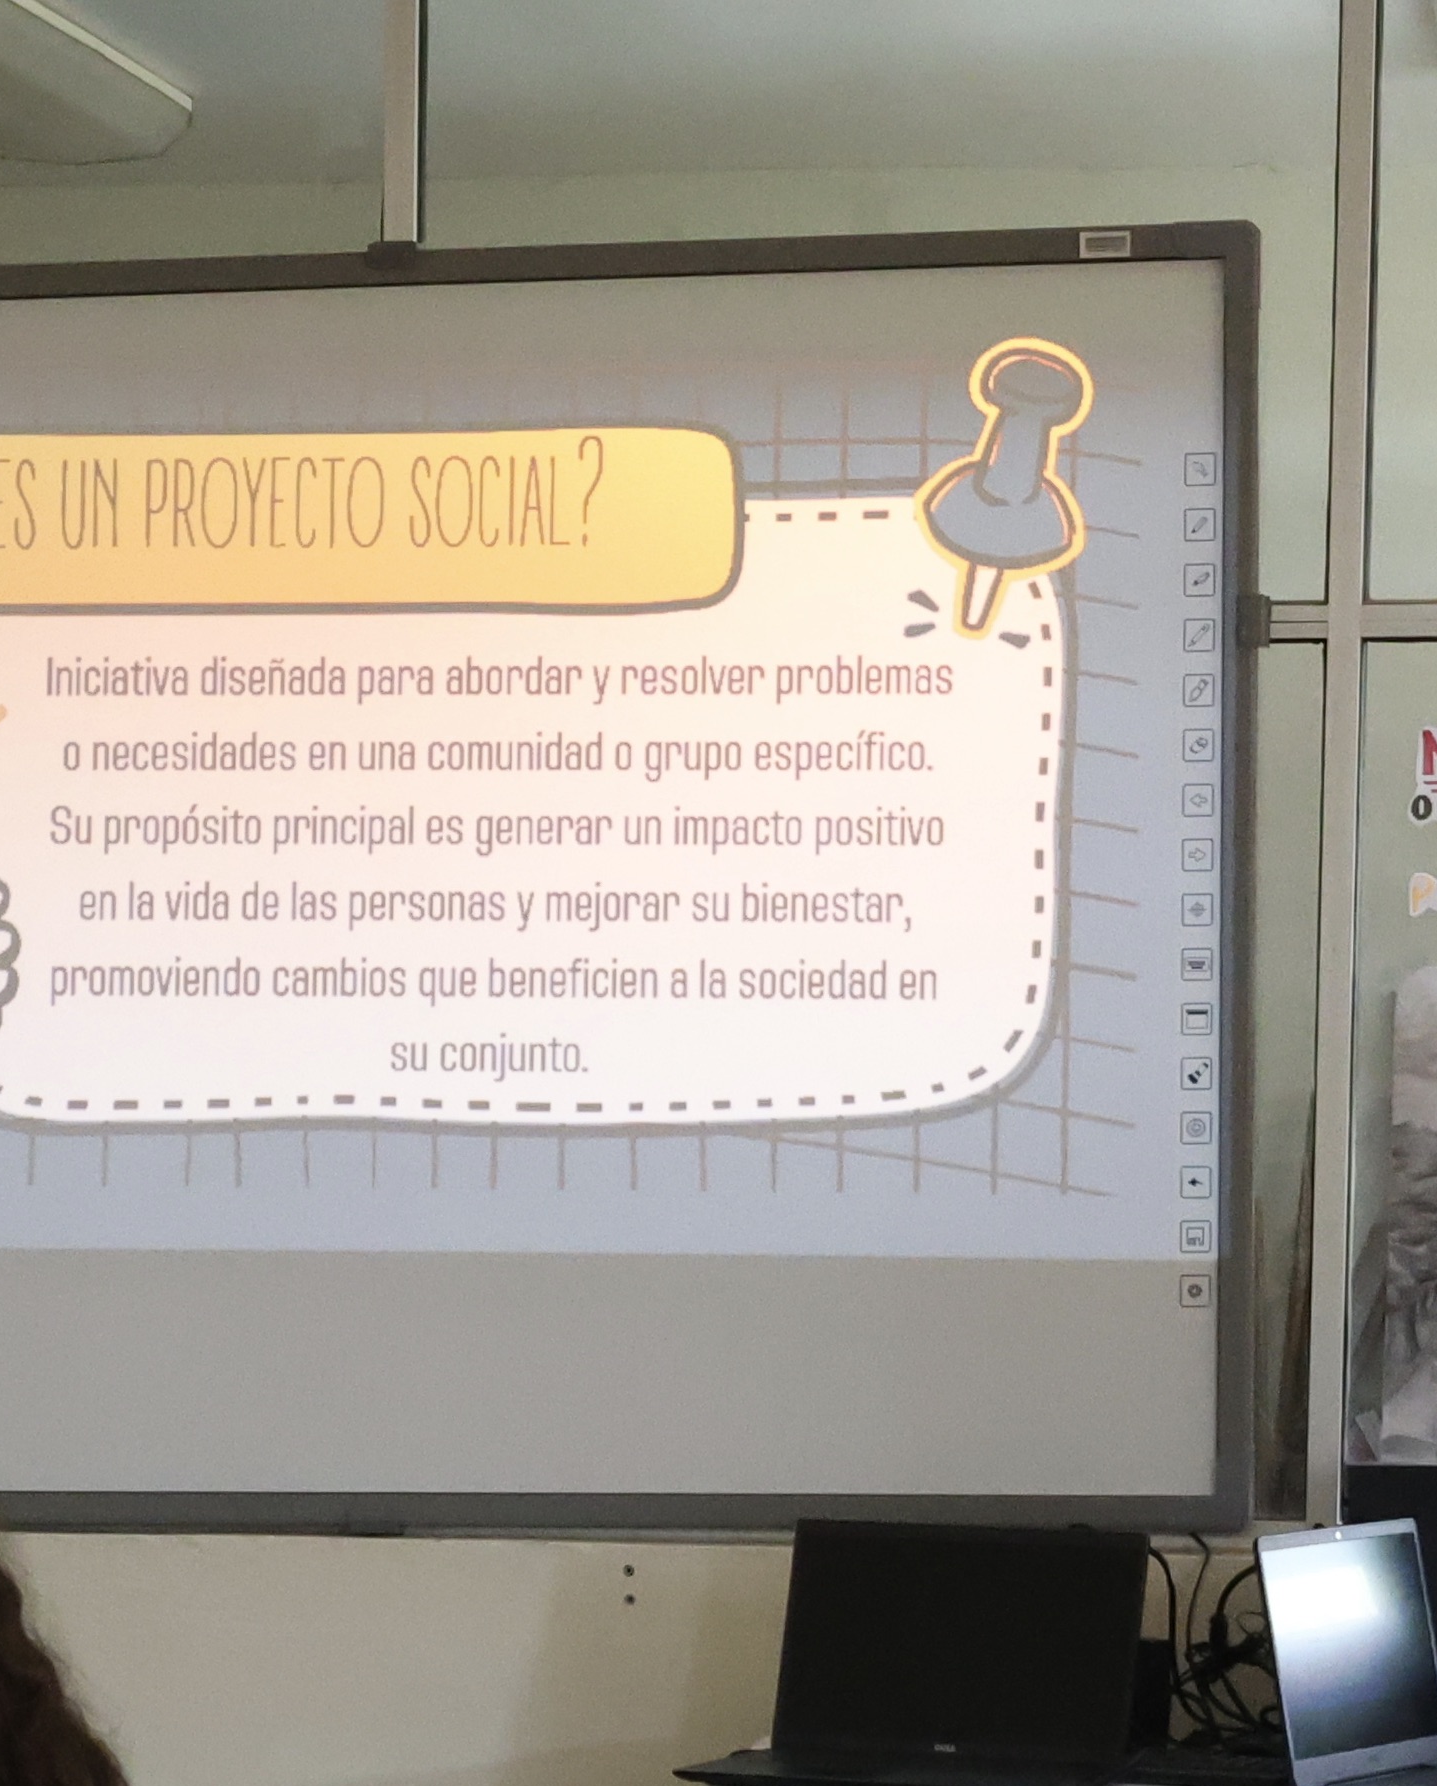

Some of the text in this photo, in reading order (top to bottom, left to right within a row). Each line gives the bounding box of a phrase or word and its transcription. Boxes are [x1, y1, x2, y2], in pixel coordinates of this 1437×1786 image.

[60, 457, 118, 550] UN
[145, 456, 385, 549] PROYECTO
[409, 437, 603, 548] SOCIAL?
[46, 655, 953, 705] Iniciativa diseñada para abordar y resolver problemas
[63, 730, 933, 783] o necesidades en una comunidad o grupo específico.
[50, 804, 944, 857] Su propósito principal es generar un impacto positivo
[79, 881, 912, 933] en la vida de las personas y mejorar su bienestar,
[51, 956, 937, 1007] promoviendo cambios que beneficien a la sociedad en
[391, 1033, 588, 1082] su conjunto.
